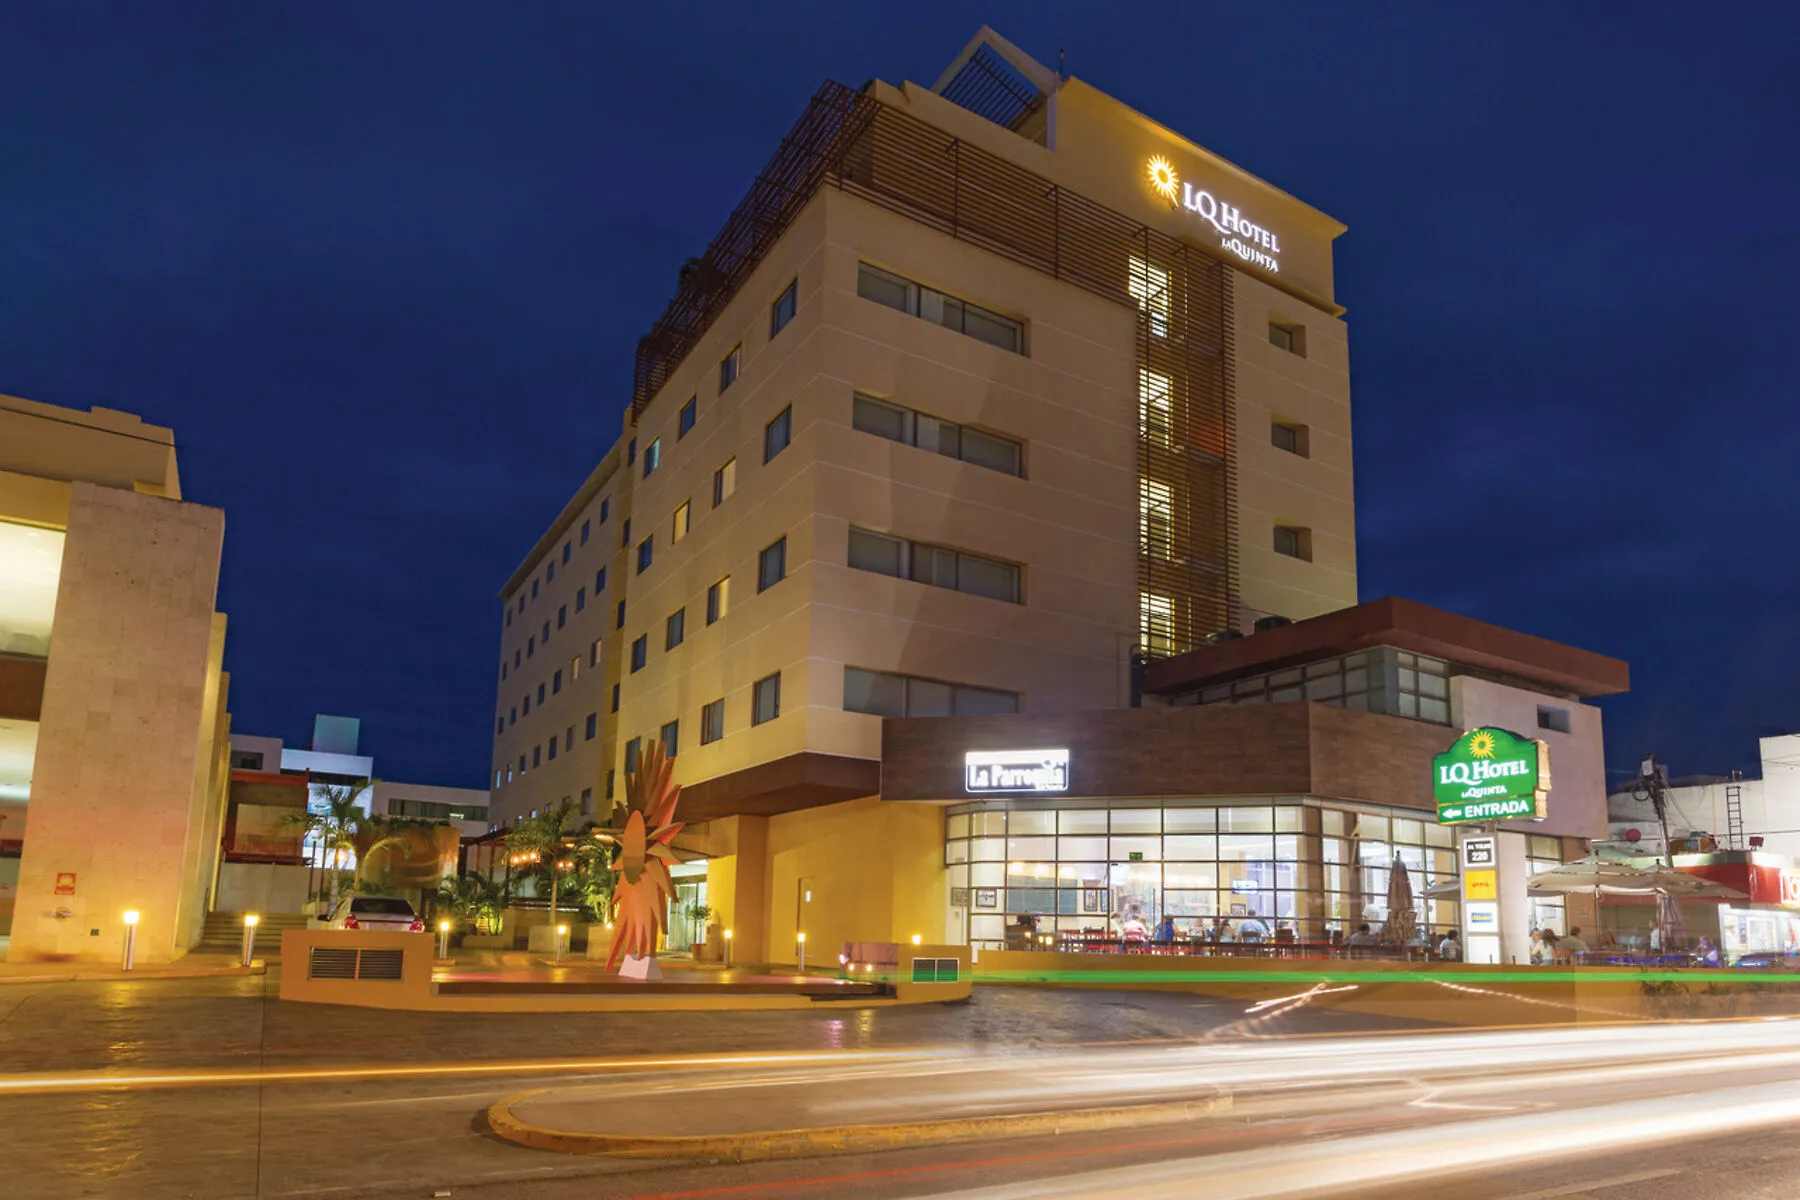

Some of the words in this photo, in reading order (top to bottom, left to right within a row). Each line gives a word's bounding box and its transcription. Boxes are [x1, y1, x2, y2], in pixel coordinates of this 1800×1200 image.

[1184, 182, 1231, 235] LQ
[1221, 201, 1280, 253] HOTEL
[1231, 238, 1279, 273] QUINTA
[969, 764, 989, 787] La
[1440, 762, 1482, 785] LQ
[1472, 760, 1529, 779] HOTEL
[1468, 785, 1508, 798] QUINTA
[1464, 799, 1529, 818] ENTRADA
